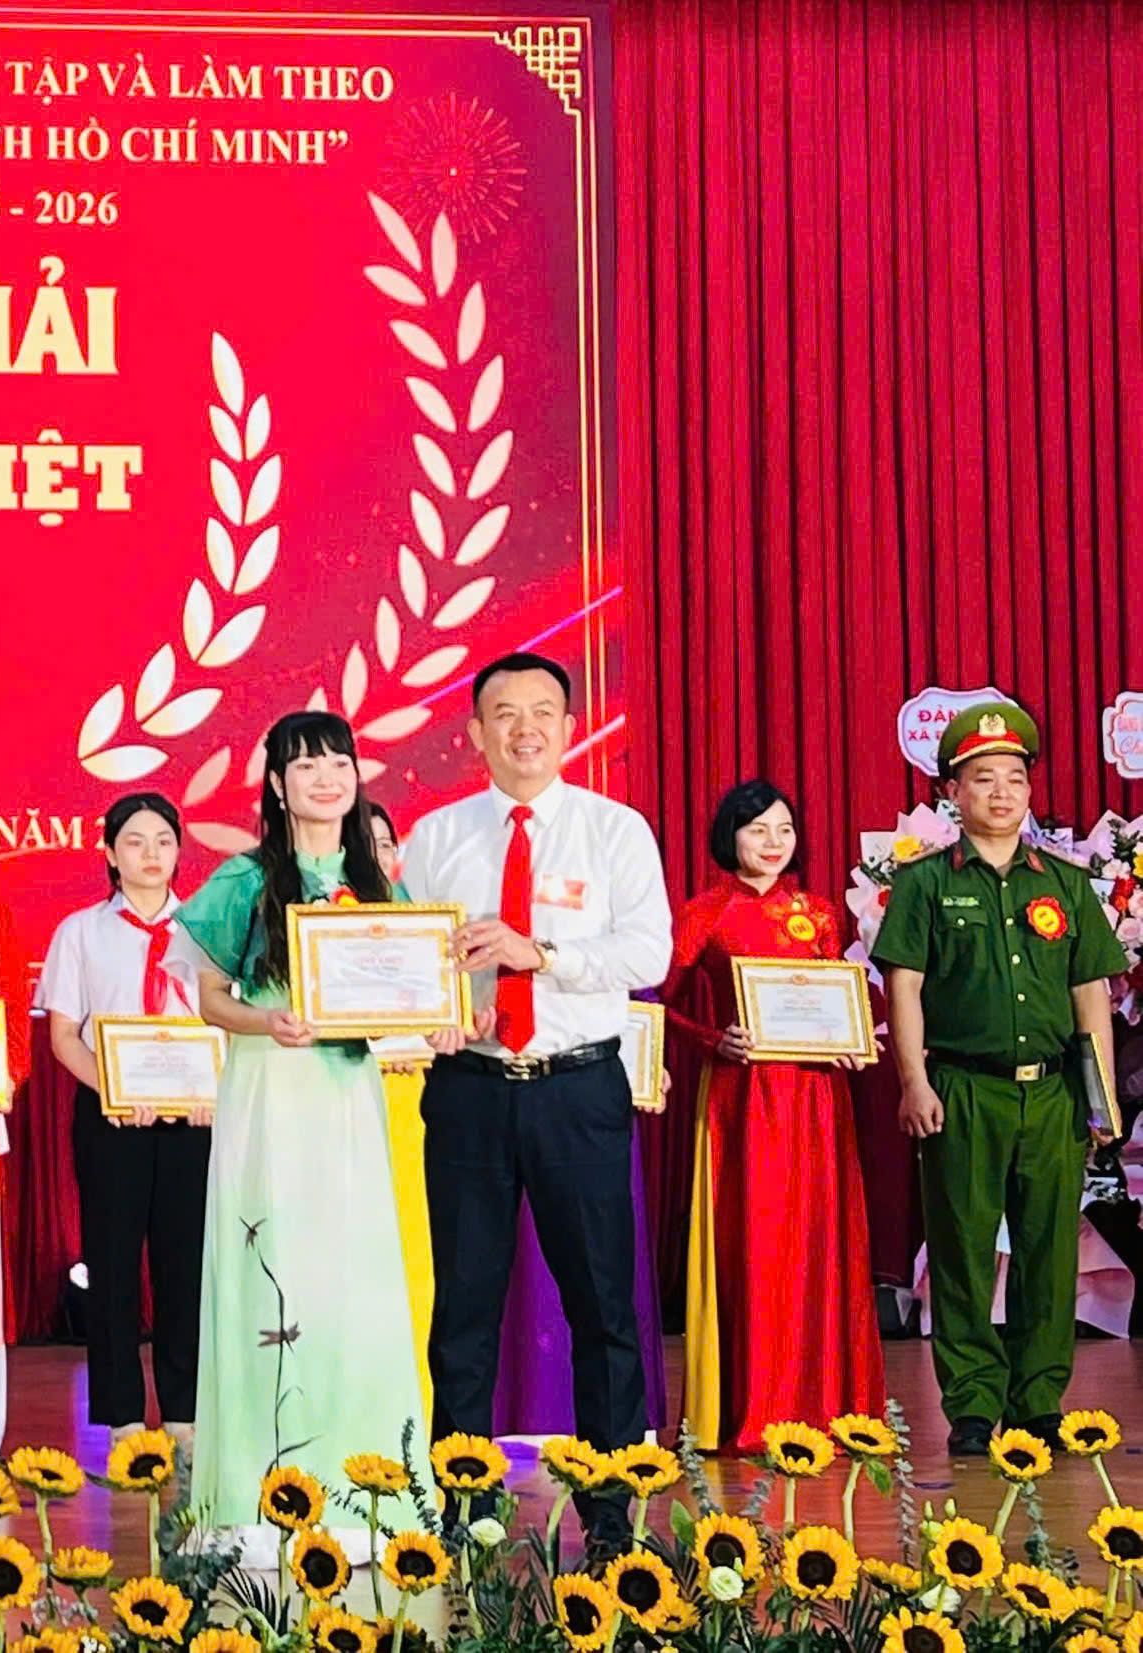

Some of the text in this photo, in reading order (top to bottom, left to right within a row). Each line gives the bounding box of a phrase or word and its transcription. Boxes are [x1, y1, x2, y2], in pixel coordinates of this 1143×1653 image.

[97, 52, 156, 97] VÀ
[169, 54, 264, 99] LÀM
[273, 66, 394, 102] THEO
[120, 118, 197, 162] CHÍ
[9, 207, 24, 215] -
[35, 191, 118, 225] 2026
